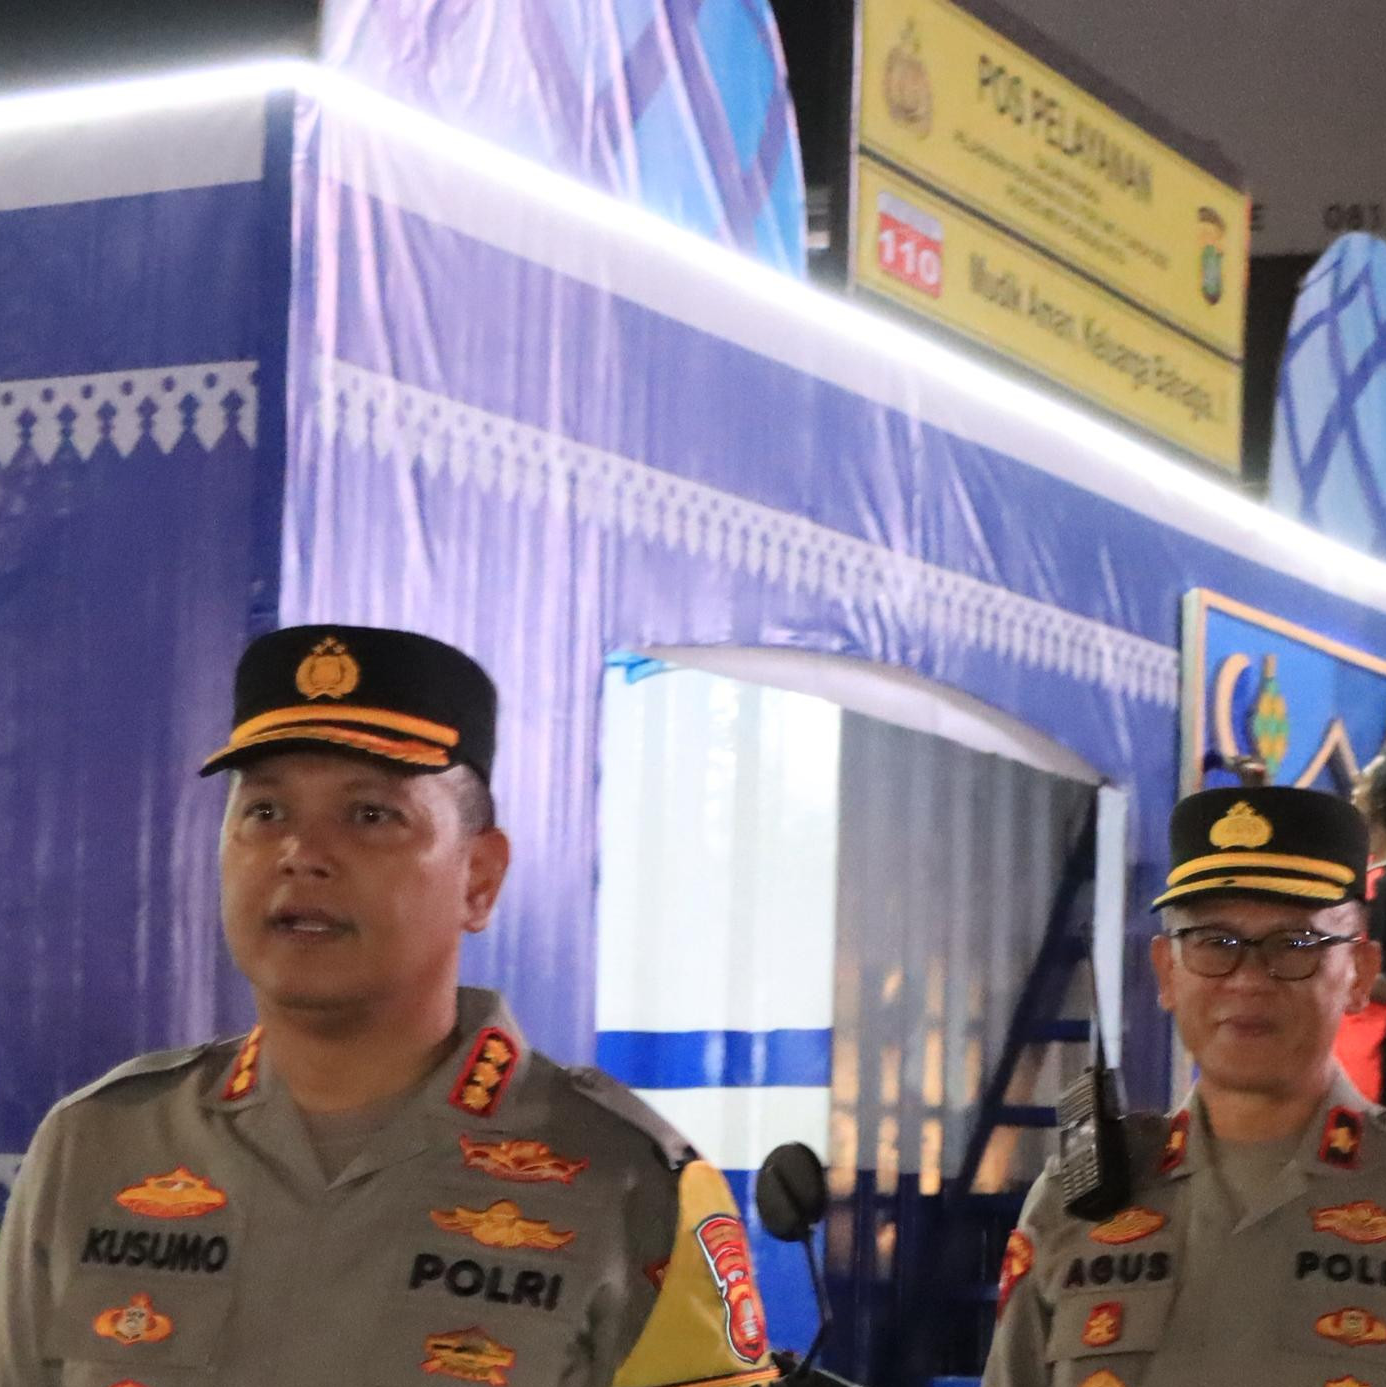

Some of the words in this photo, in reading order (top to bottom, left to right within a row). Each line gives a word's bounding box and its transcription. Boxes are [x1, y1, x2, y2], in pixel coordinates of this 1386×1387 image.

[878, 228, 941, 286] 110
[80, 1227, 229, 1274] KUSUMO
[1062, 1251, 1170, 1290] AGUS
[409, 1252, 564, 1310] POLRI
